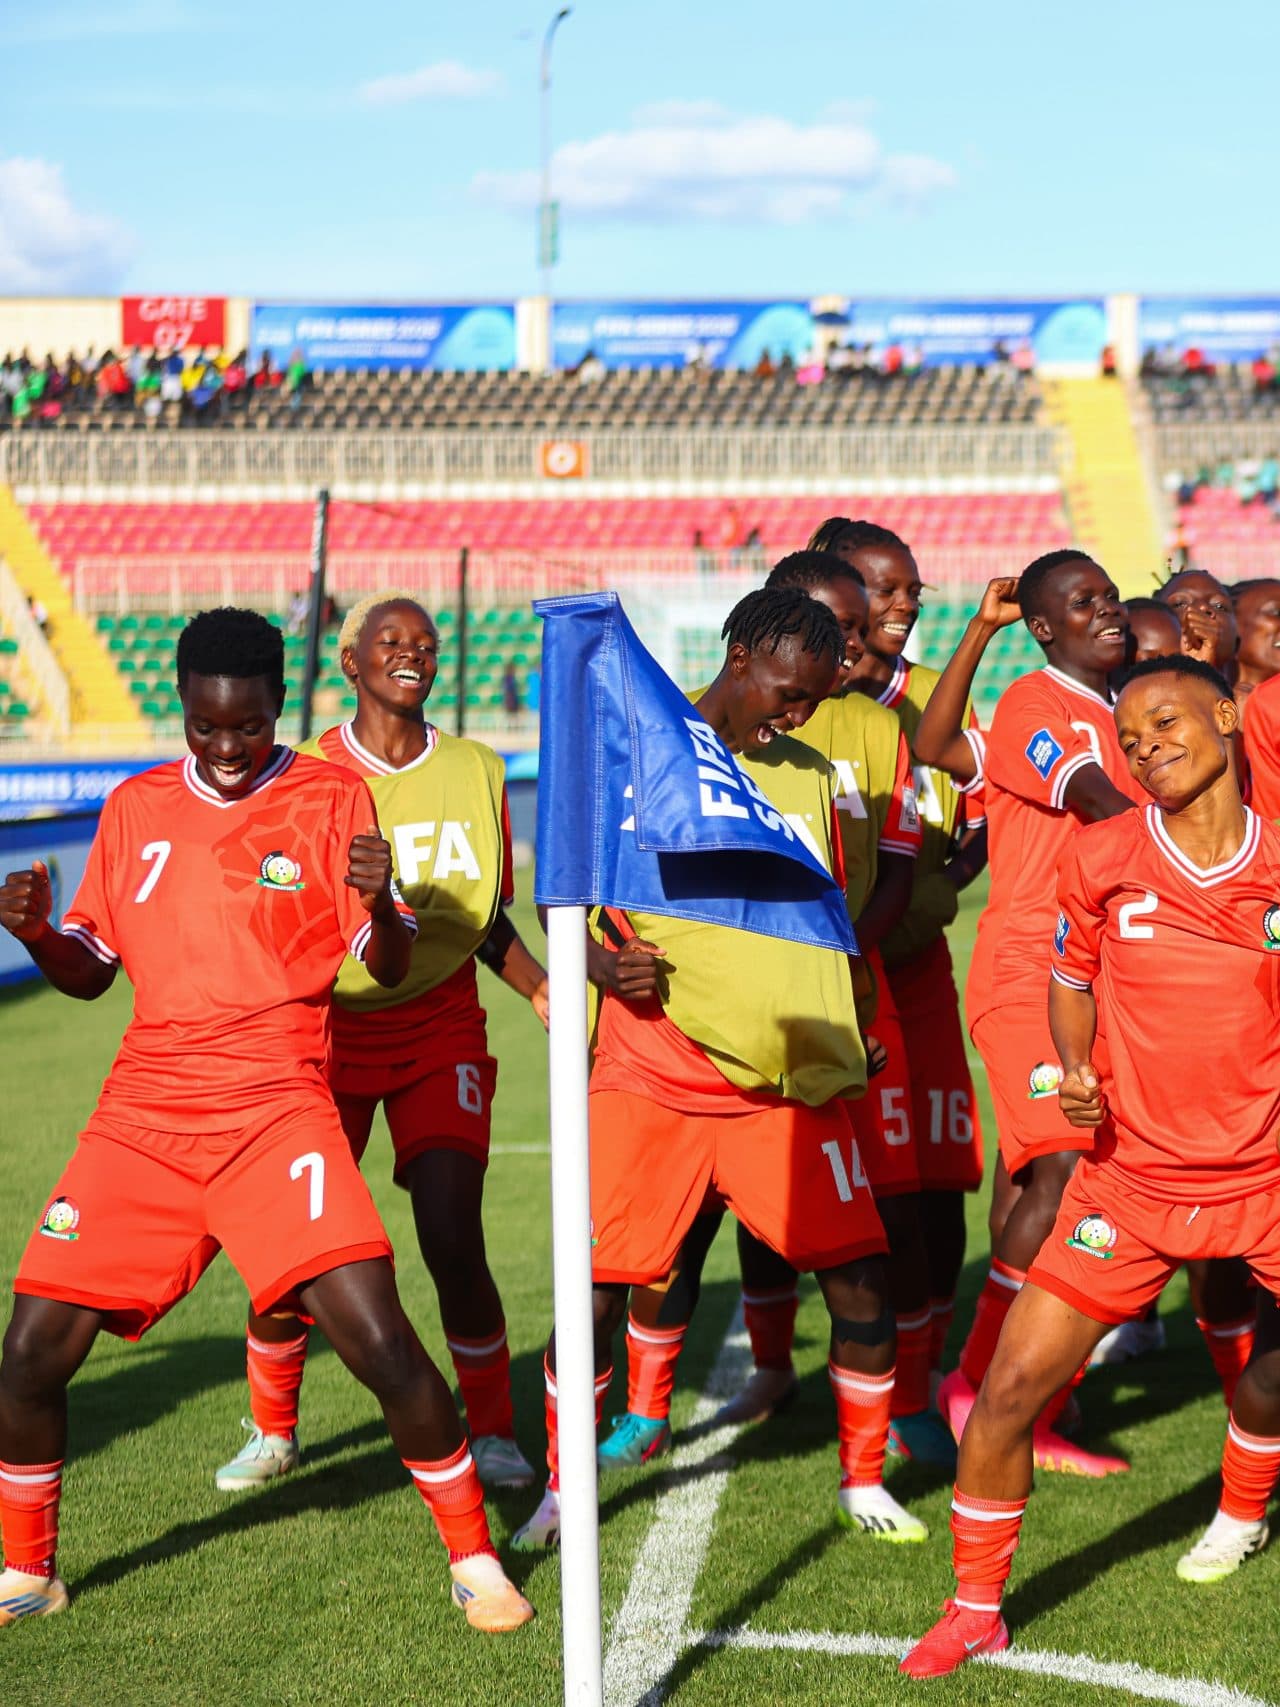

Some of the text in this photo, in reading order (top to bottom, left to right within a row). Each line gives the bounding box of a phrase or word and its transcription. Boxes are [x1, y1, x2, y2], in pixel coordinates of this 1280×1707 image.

[139, 296, 208, 321] GATE
[135, 841, 171, 903] 7
[1119, 891, 1159, 939] 2
[456, 1063, 482, 1115] 6
[881, 1087, 910, 1146] 5
[928, 1089, 973, 1144] 16
[289, 1152, 325, 1221] 7
